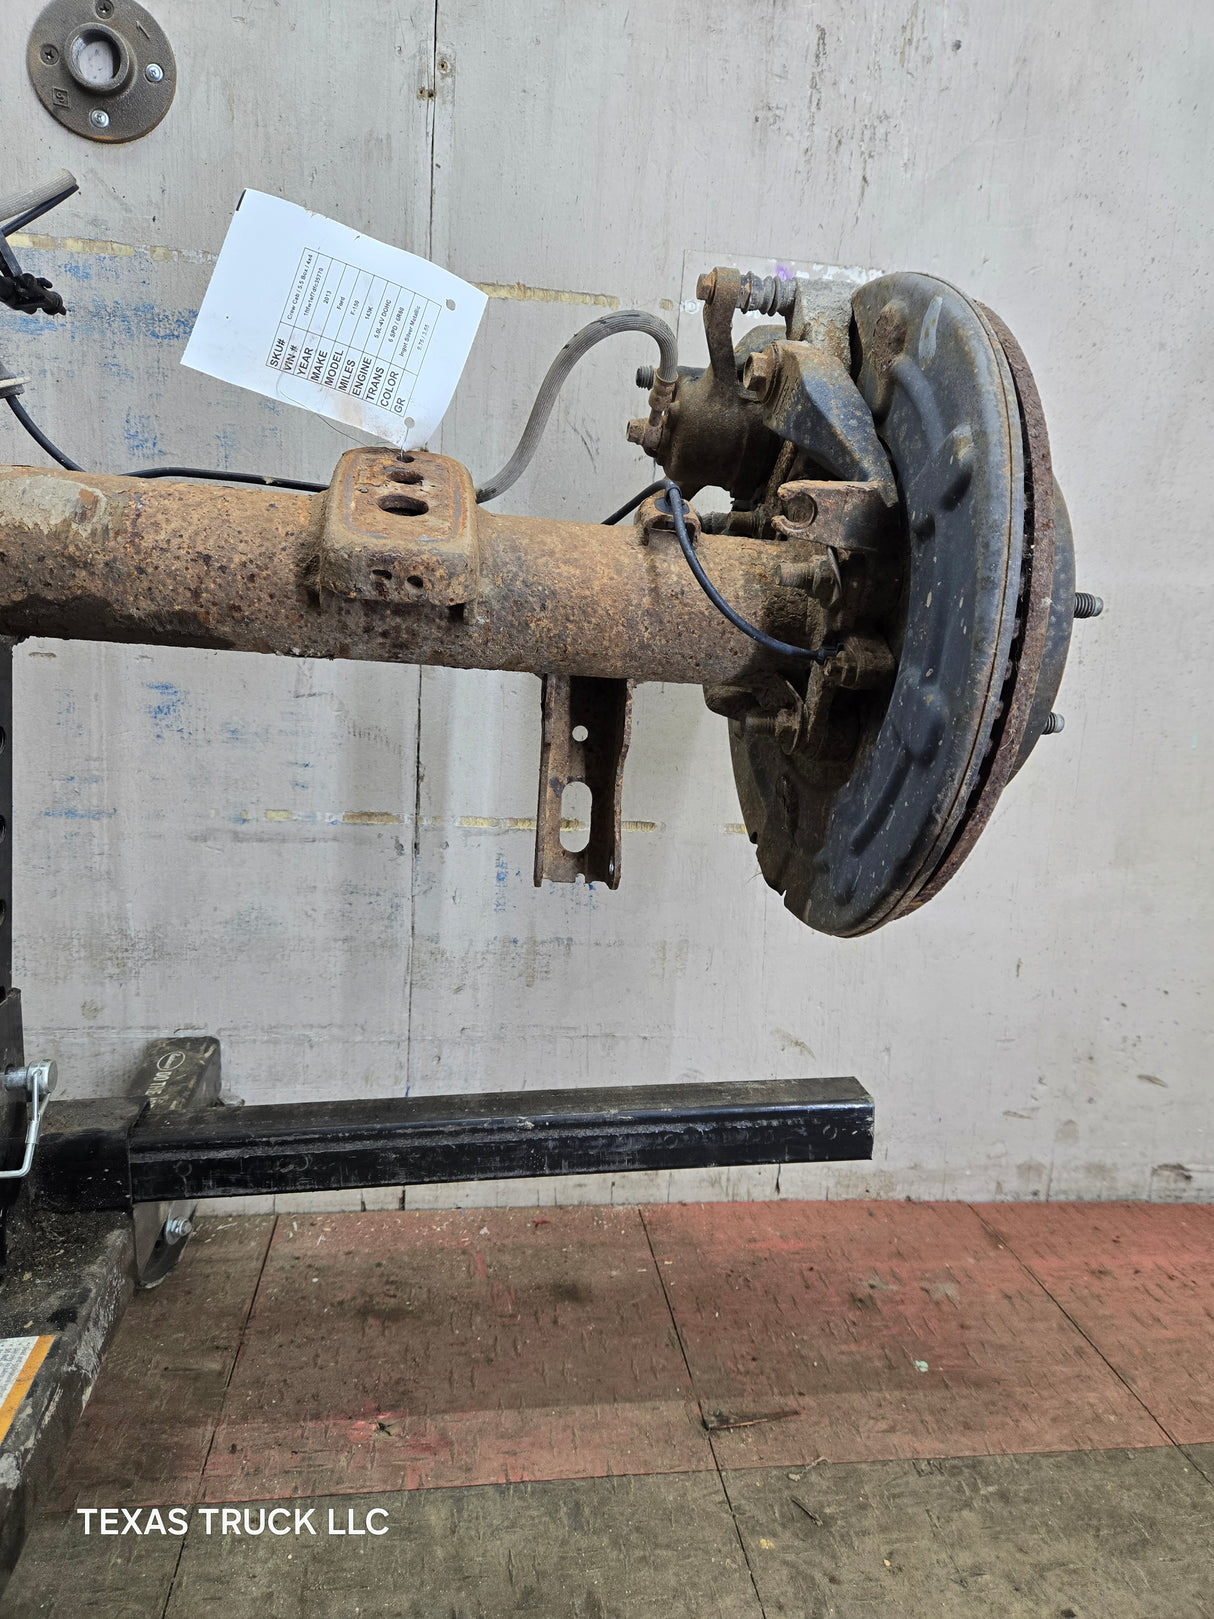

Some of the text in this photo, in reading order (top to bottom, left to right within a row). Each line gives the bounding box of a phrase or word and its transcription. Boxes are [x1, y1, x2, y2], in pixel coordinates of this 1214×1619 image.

[287, 304, 296, 320] Crew
[301, 268, 309, 281] Box
[323, 290, 332, 305] 2013
[337, 296, 346, 311] Ford
[350, 299, 360, 316] F-150
[381, 299, 392, 318] DOHC
[390, 324, 398, 338] SPD
[399, 305, 421, 357] Ingot Silver Metallic
[270, 337, 286, 367] SKU#
[283, 344, 298, 371] VIN #
[297, 347, 314, 375] YEAR
[311, 349, 328, 382] MAKE
[324, 350, 344, 387] MODEL
[338, 359, 356, 392] MILES
[352, 356, 373, 397] ENGINE
[366, 366, 385, 401] TRANS
[381, 370, 399, 407] COLOR
[394, 397, 406, 414] GR
